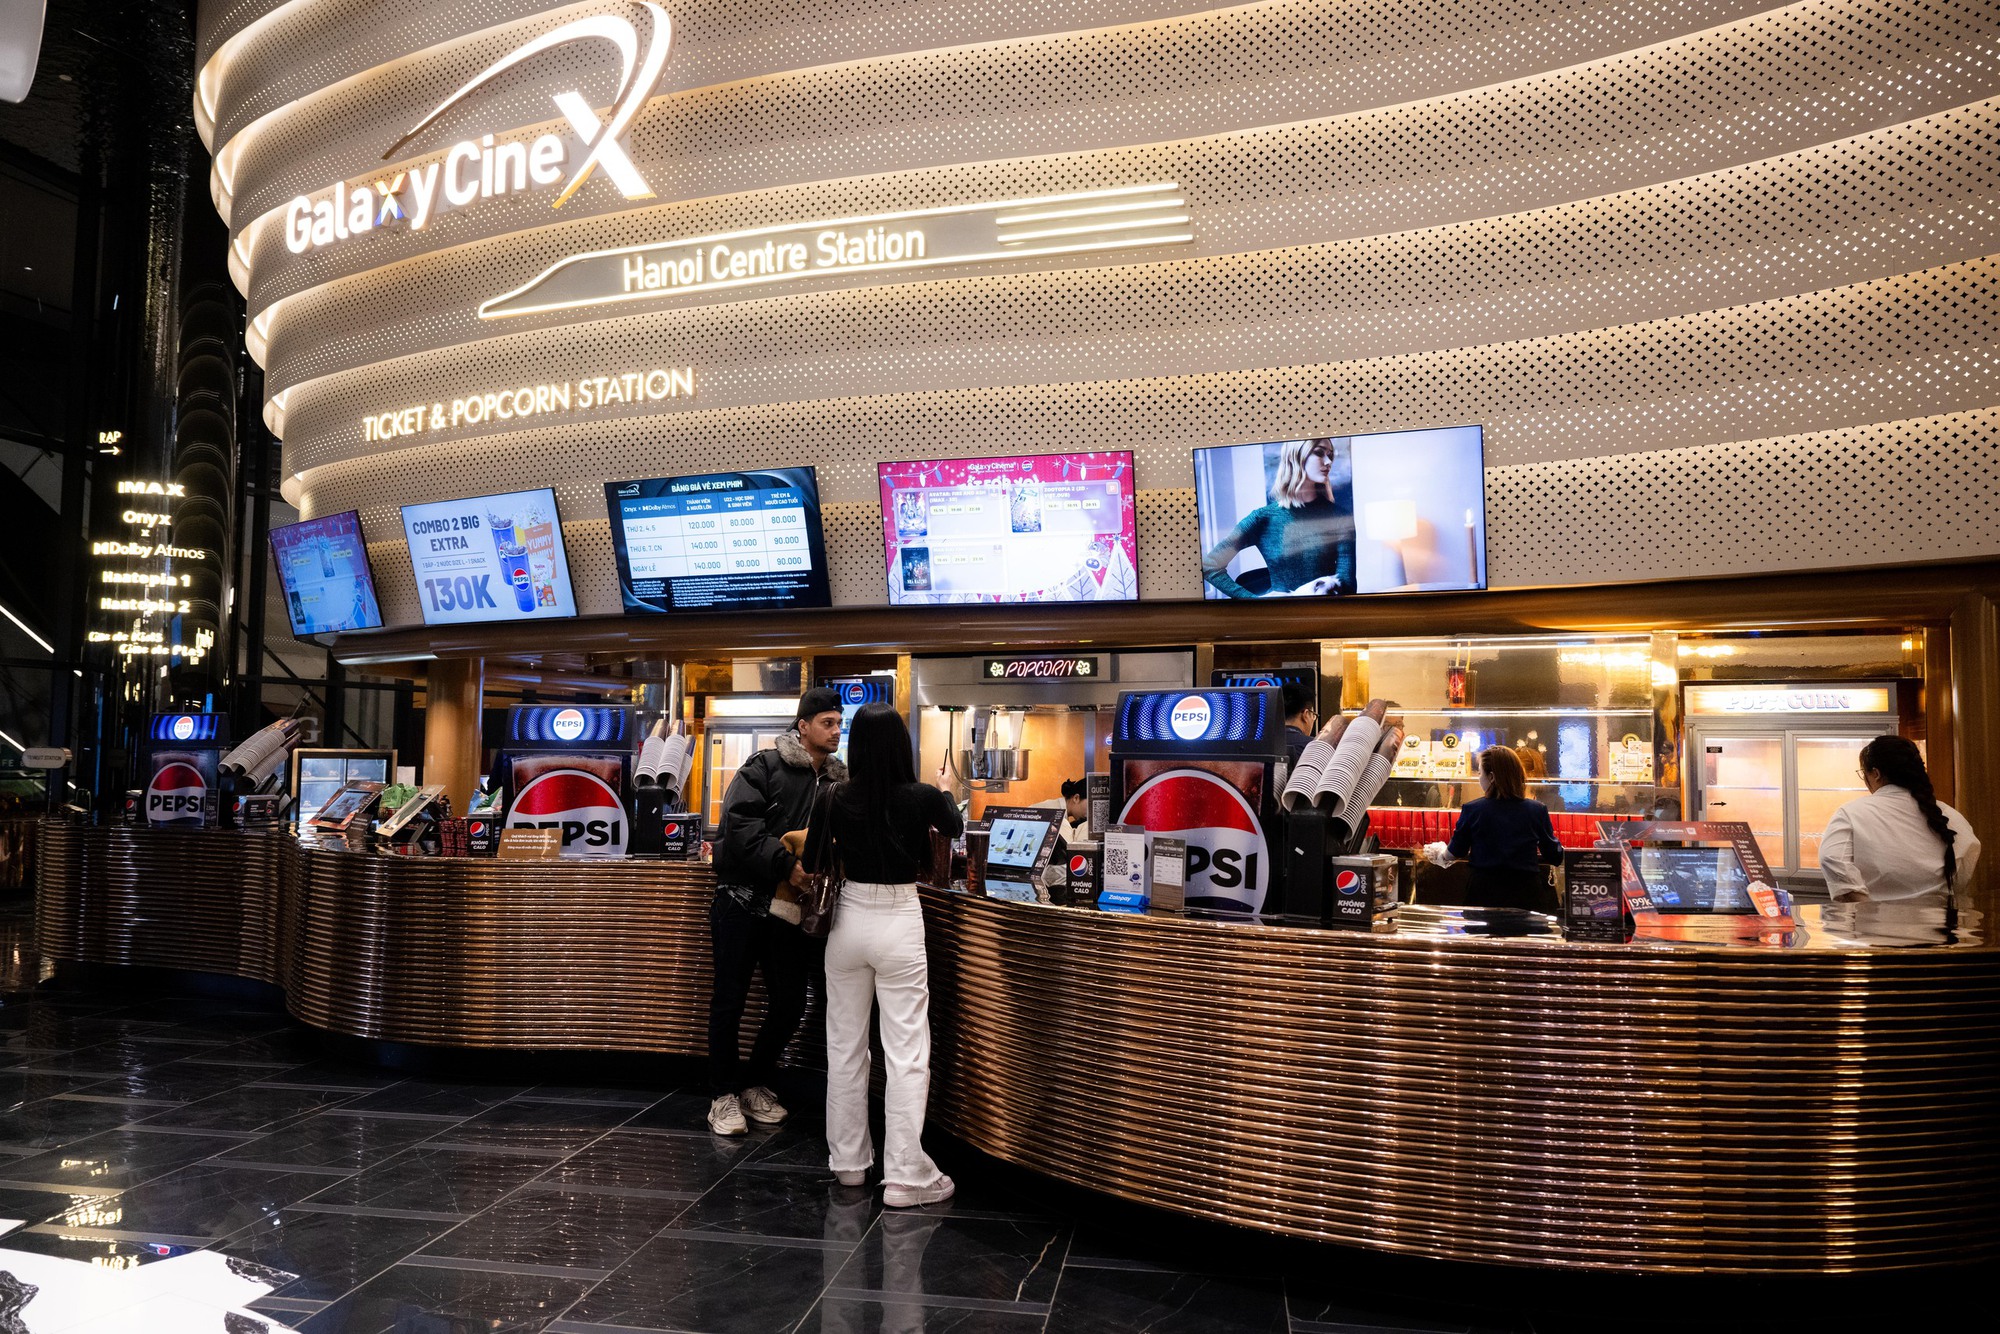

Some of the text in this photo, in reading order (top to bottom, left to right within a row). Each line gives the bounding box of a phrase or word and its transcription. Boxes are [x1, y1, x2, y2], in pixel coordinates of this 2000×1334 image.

[622, 228, 926, 292] Hanoi Centre Station
[363, 367, 696, 442] TICKET & POPCORN STATION
[117, 481, 185, 497] IMAX
[712, 481, 725, 489] XEM
[726, 480, 743, 488] PHIM
[122, 510, 172, 528] Onyx
[771, 515, 797, 524] 80.000
[412, 515, 480, 535] COMBO 2 BIG
[688, 521, 715, 530] 120.000
[430, 535, 469, 552] EXTRA
[527, 534, 552, 550] YUMMY
[691, 541, 718, 550] 140.000
[733, 538, 758, 547] 90.000
[774, 536, 799, 545] 90.000
[109, 541, 205, 559] Dolby Atmos
[694, 561, 721, 570] 140.000
[736, 559, 760, 568] 90.000
[777, 557, 802, 566] 90.000
[180, 574, 191, 587] 1
[424, 574, 497, 612] 130K
[178, 600, 190, 613] 2
[1005, 659, 1076, 677] POPCORN
[1788, 693, 1850, 709] CORN
[1174, 712, 1208, 722] PEPSI
[555, 720, 582, 728] PEPSI
[150, 795, 204, 812] PEPSI
[1703, 823, 1747, 834] AVATAR
[1071, 880, 1093, 889] KHÔNG
[1571, 884, 1608, 896] 2.500
[1108, 894, 1131, 902] Zalopay
[1337, 899, 1366, 908] KHÔNG
[1628, 897, 1653, 908] 199k
[1341, 907, 1362, 915] CALO
